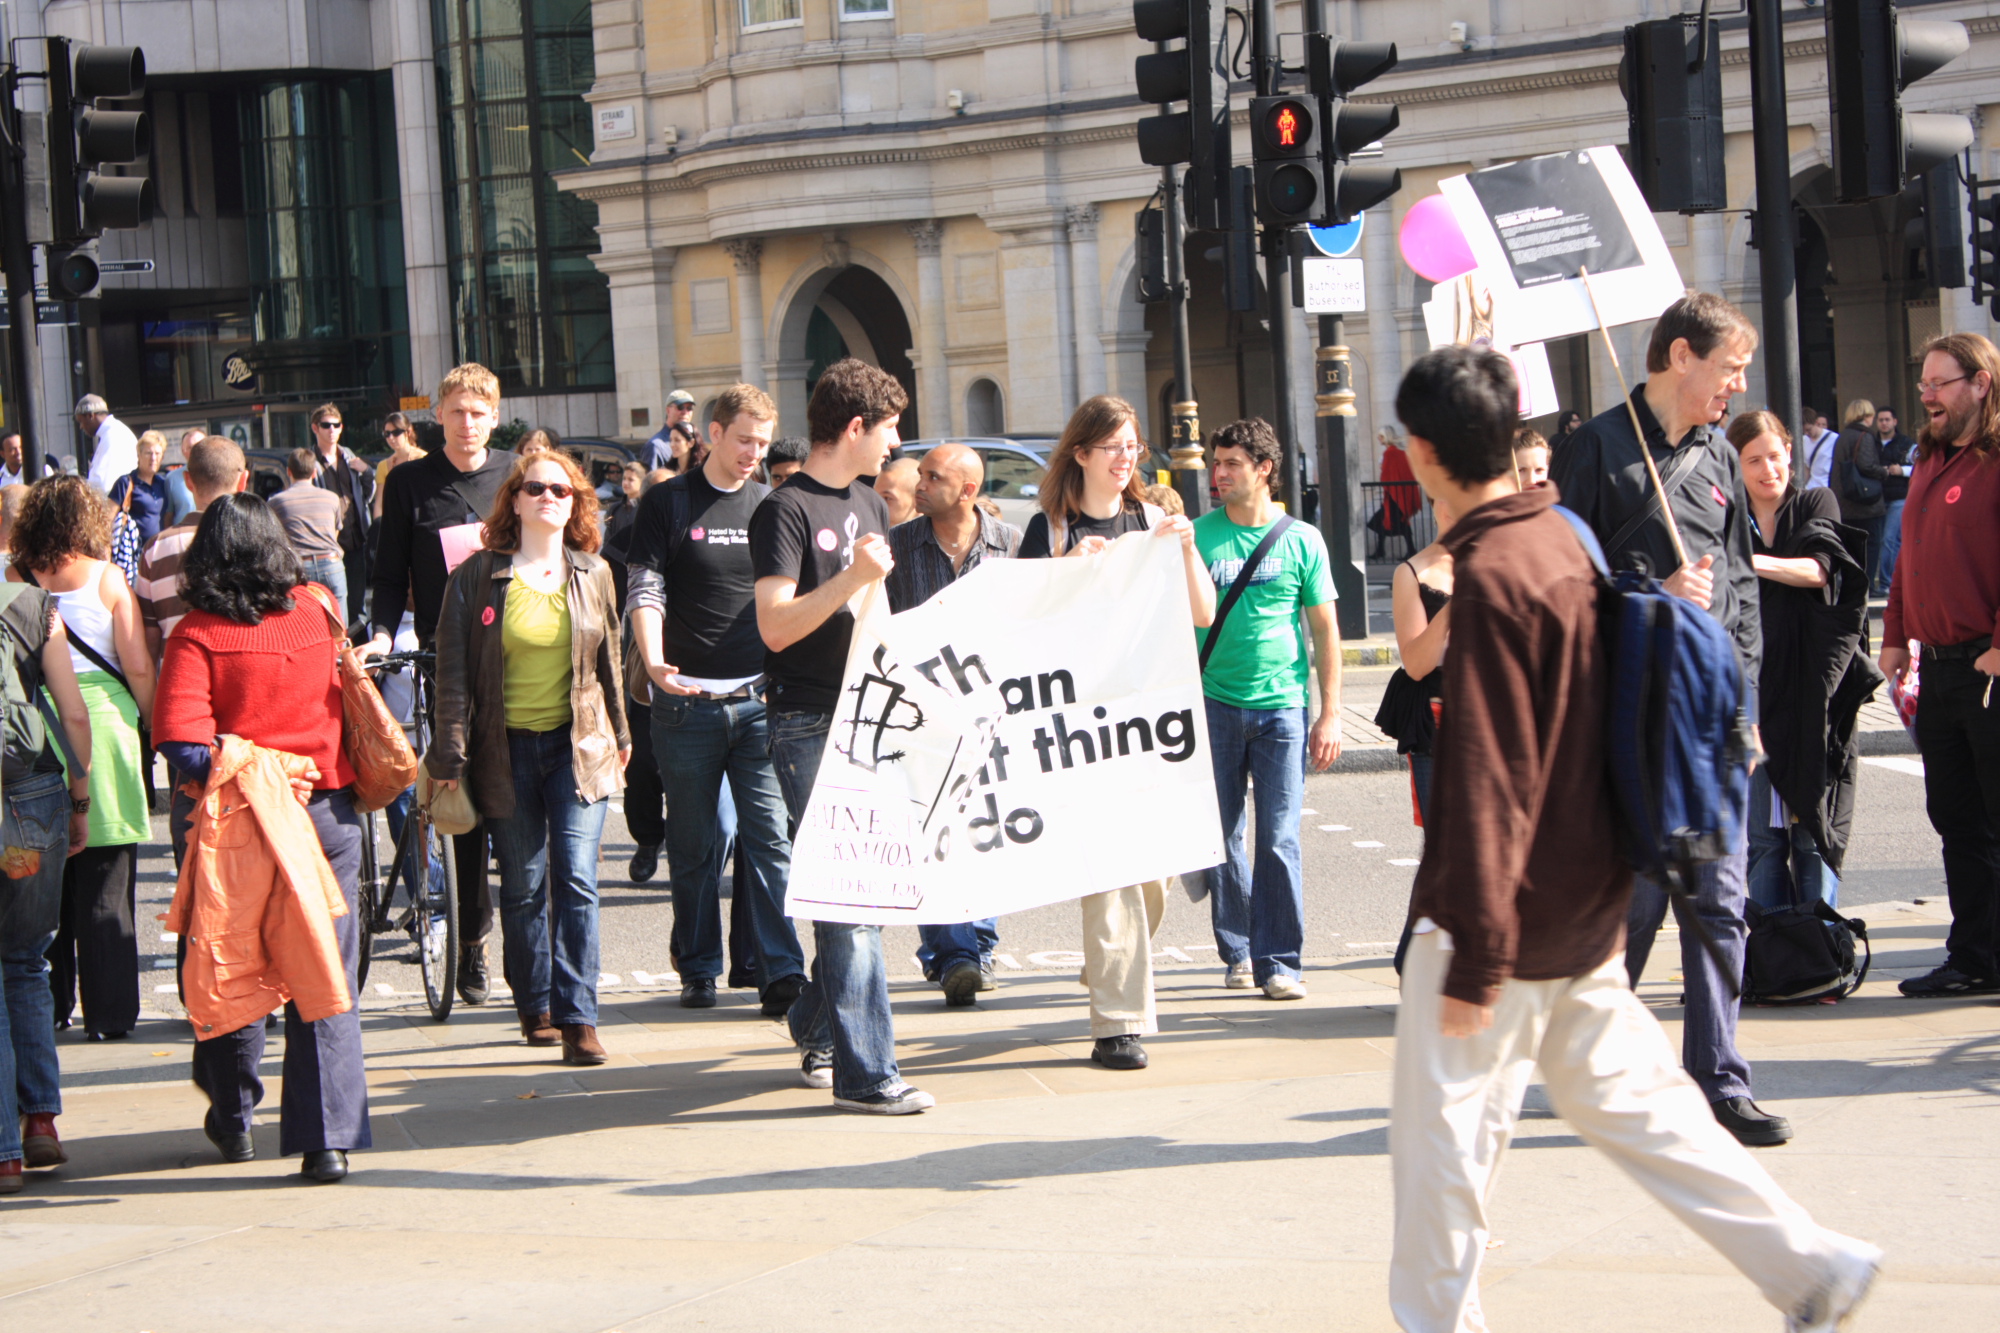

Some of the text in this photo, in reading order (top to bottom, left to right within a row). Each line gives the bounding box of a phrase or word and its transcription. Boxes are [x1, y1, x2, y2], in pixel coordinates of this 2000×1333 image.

[601, 110, 624, 121] STRAND
[1308, 281, 1360, 291] authorised
[1309, 296, 1360, 307] buses only
[728, 528, 738, 536] by
[1032, 706, 1196, 773] thing
[967, 793, 1044, 853] do
